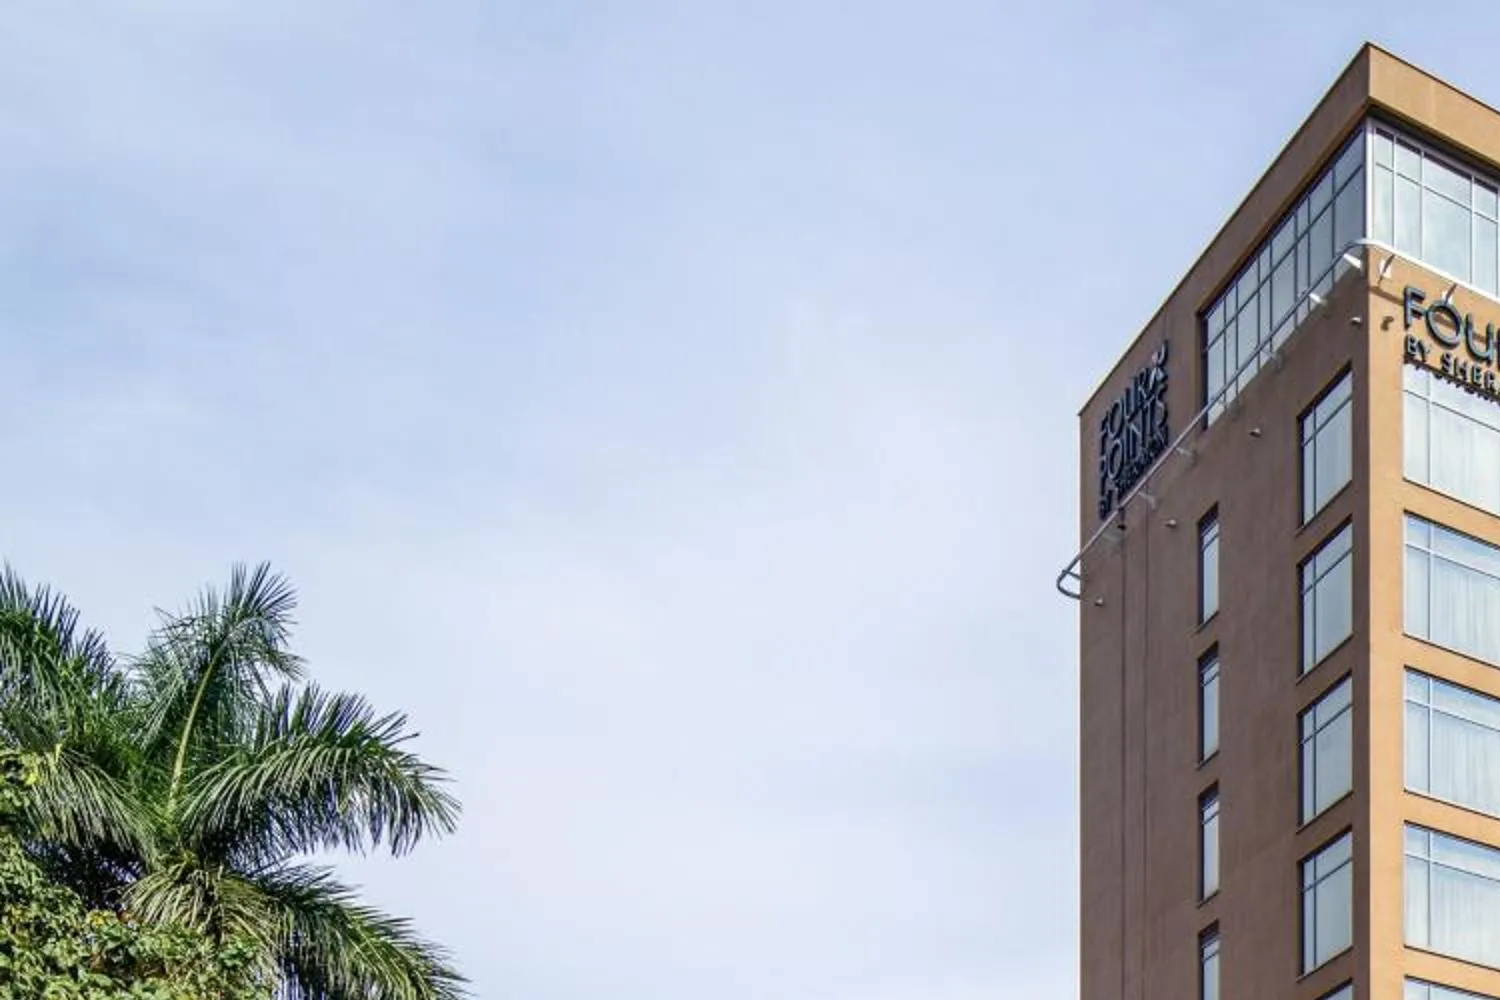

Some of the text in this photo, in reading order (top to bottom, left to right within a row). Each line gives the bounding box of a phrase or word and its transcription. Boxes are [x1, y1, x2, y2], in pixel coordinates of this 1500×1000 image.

[1404, 334, 1429, 364] BY
[1099, 384, 1169, 498] POINTS
[1100, 366, 1149, 457] FOUR
